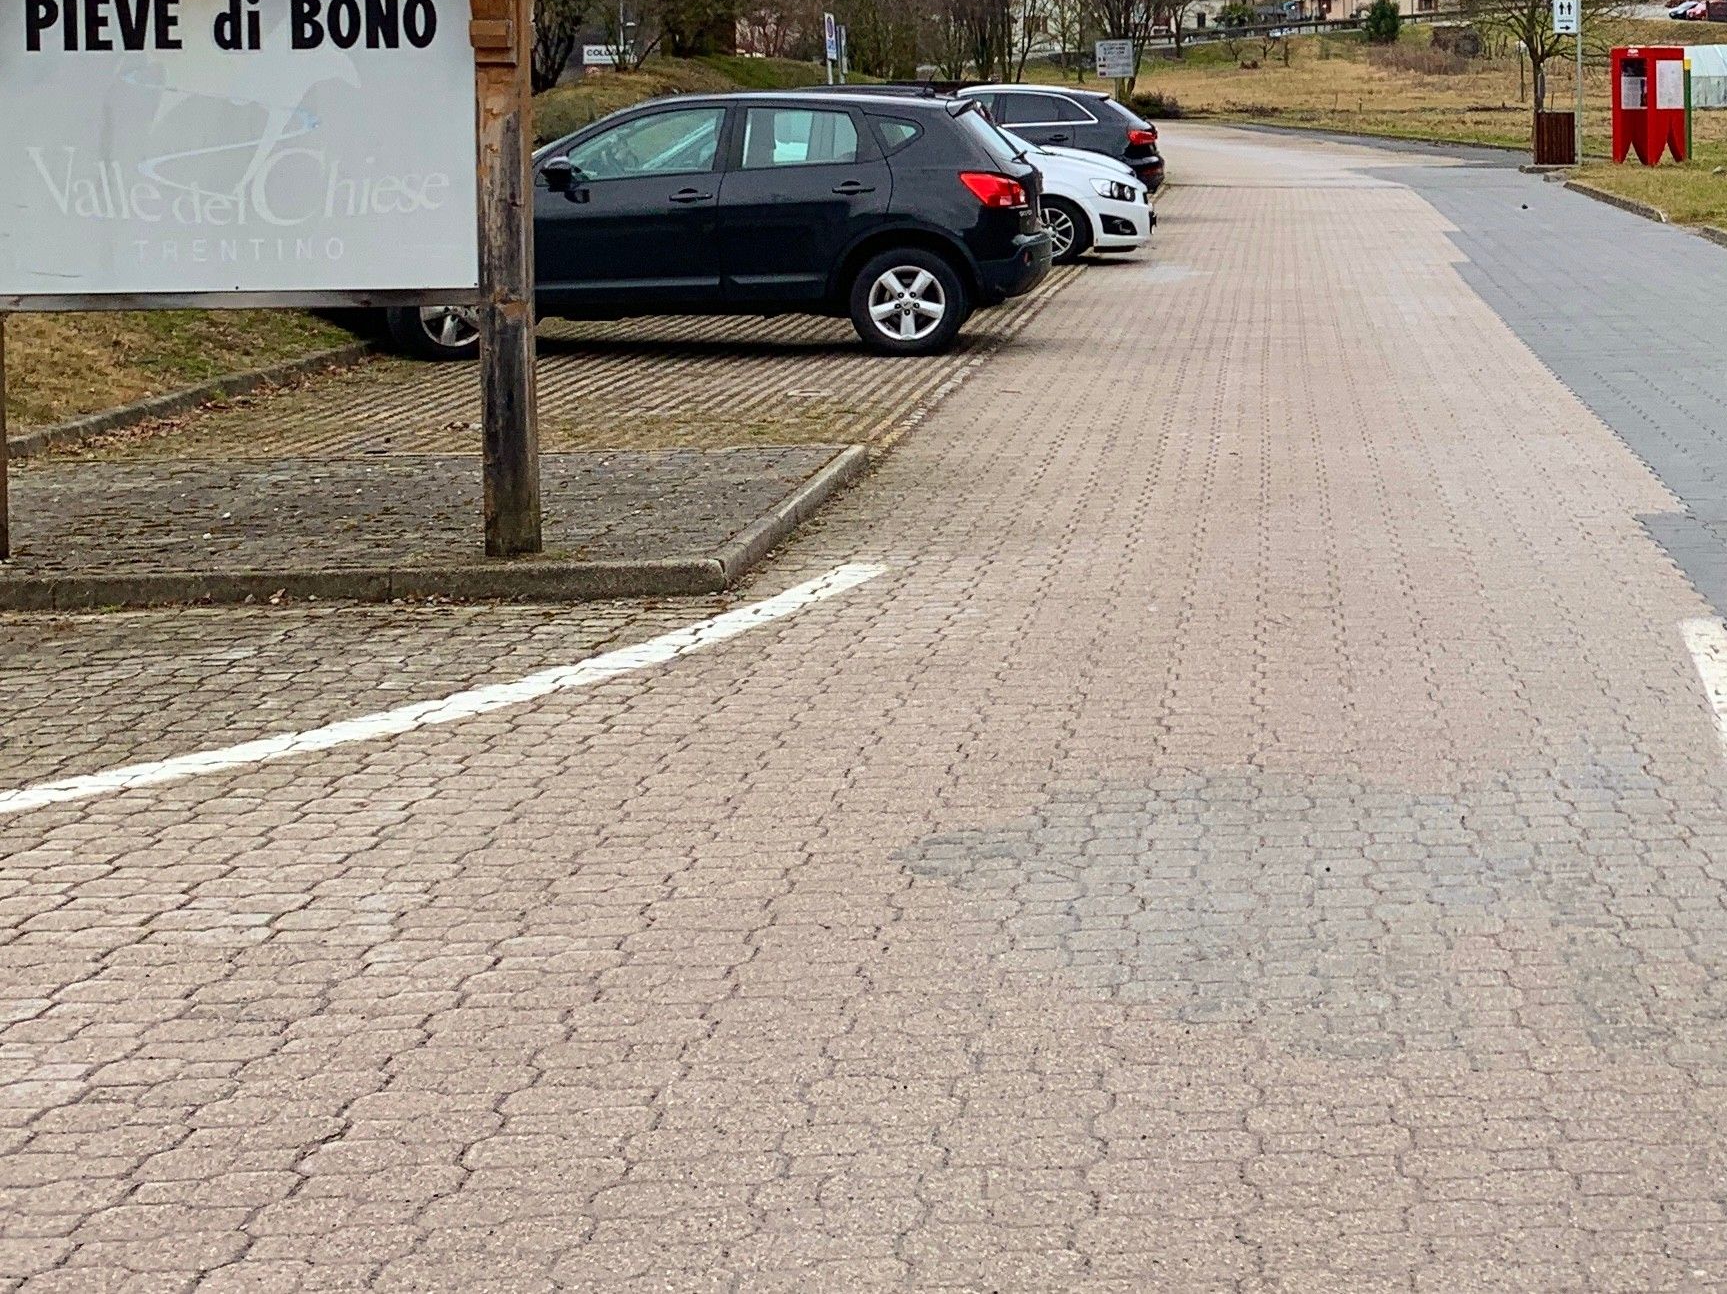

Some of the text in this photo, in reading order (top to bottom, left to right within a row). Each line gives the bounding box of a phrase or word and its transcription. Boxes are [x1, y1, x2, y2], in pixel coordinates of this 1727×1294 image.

[26, 146, 450, 227] Valle del Chiese
[132, 236, 345, 262] TRENTINO
